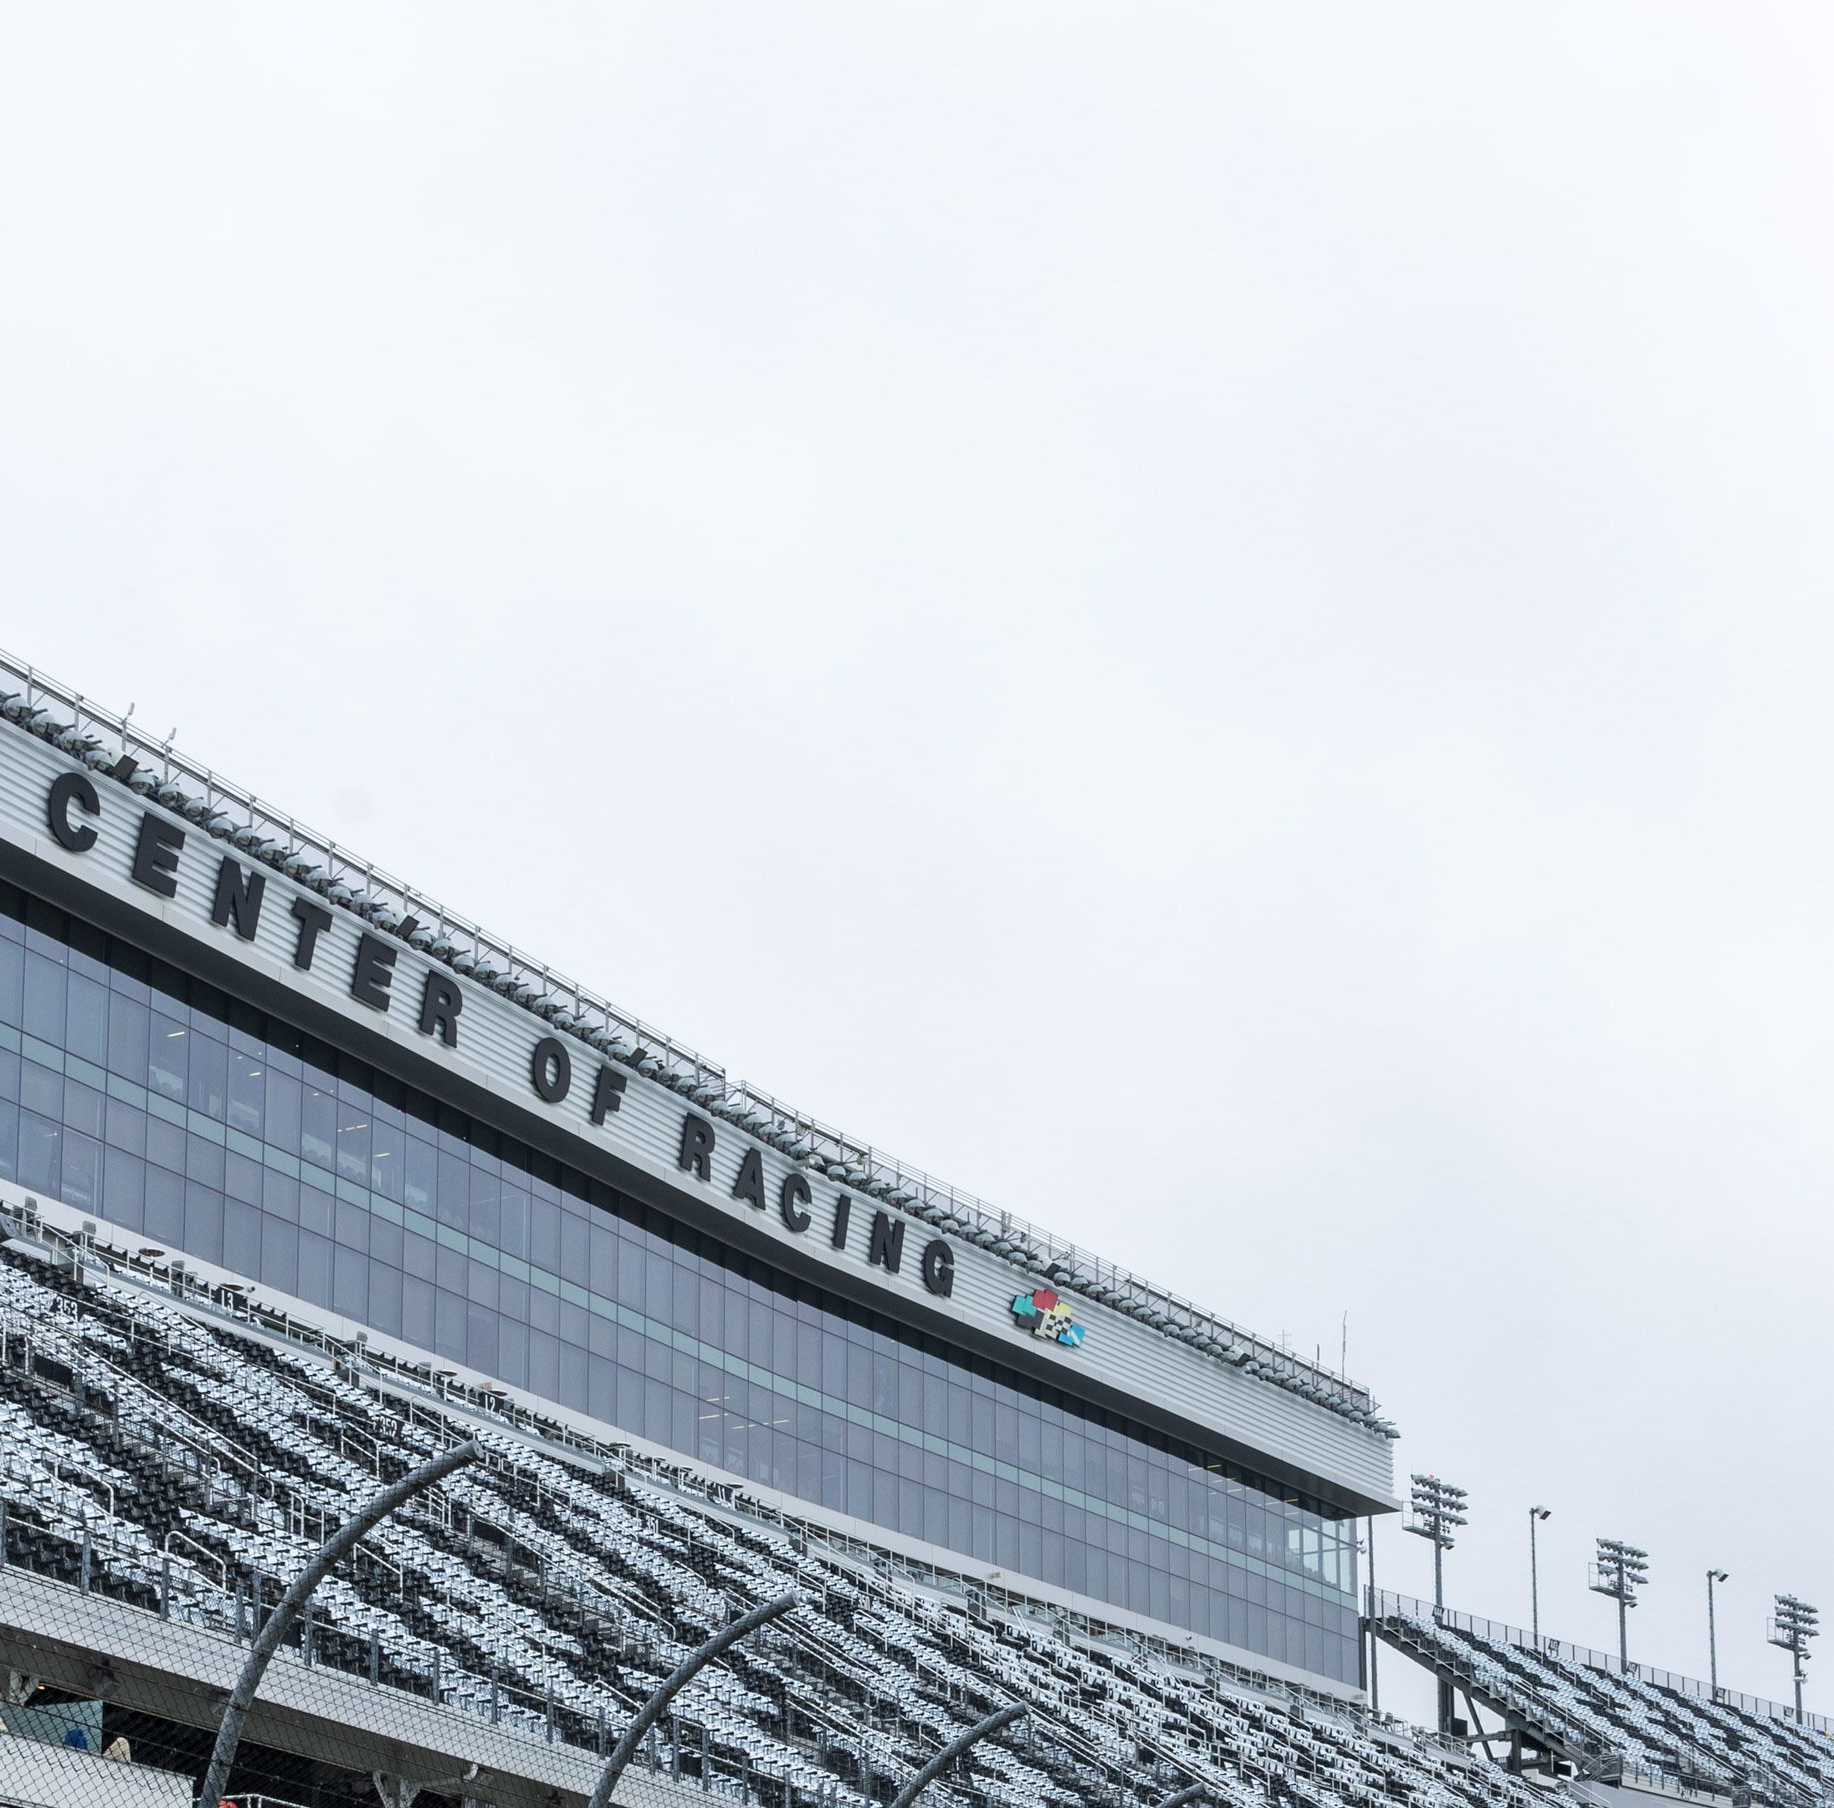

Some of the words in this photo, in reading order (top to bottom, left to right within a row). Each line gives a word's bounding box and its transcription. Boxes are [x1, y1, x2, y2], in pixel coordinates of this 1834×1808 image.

[47, 771, 465, 1048] CENTER
[531, 1037, 628, 1126] OF
[679, 1112, 956, 1298] RACING
[56, 1296, 78, 1327] 353
